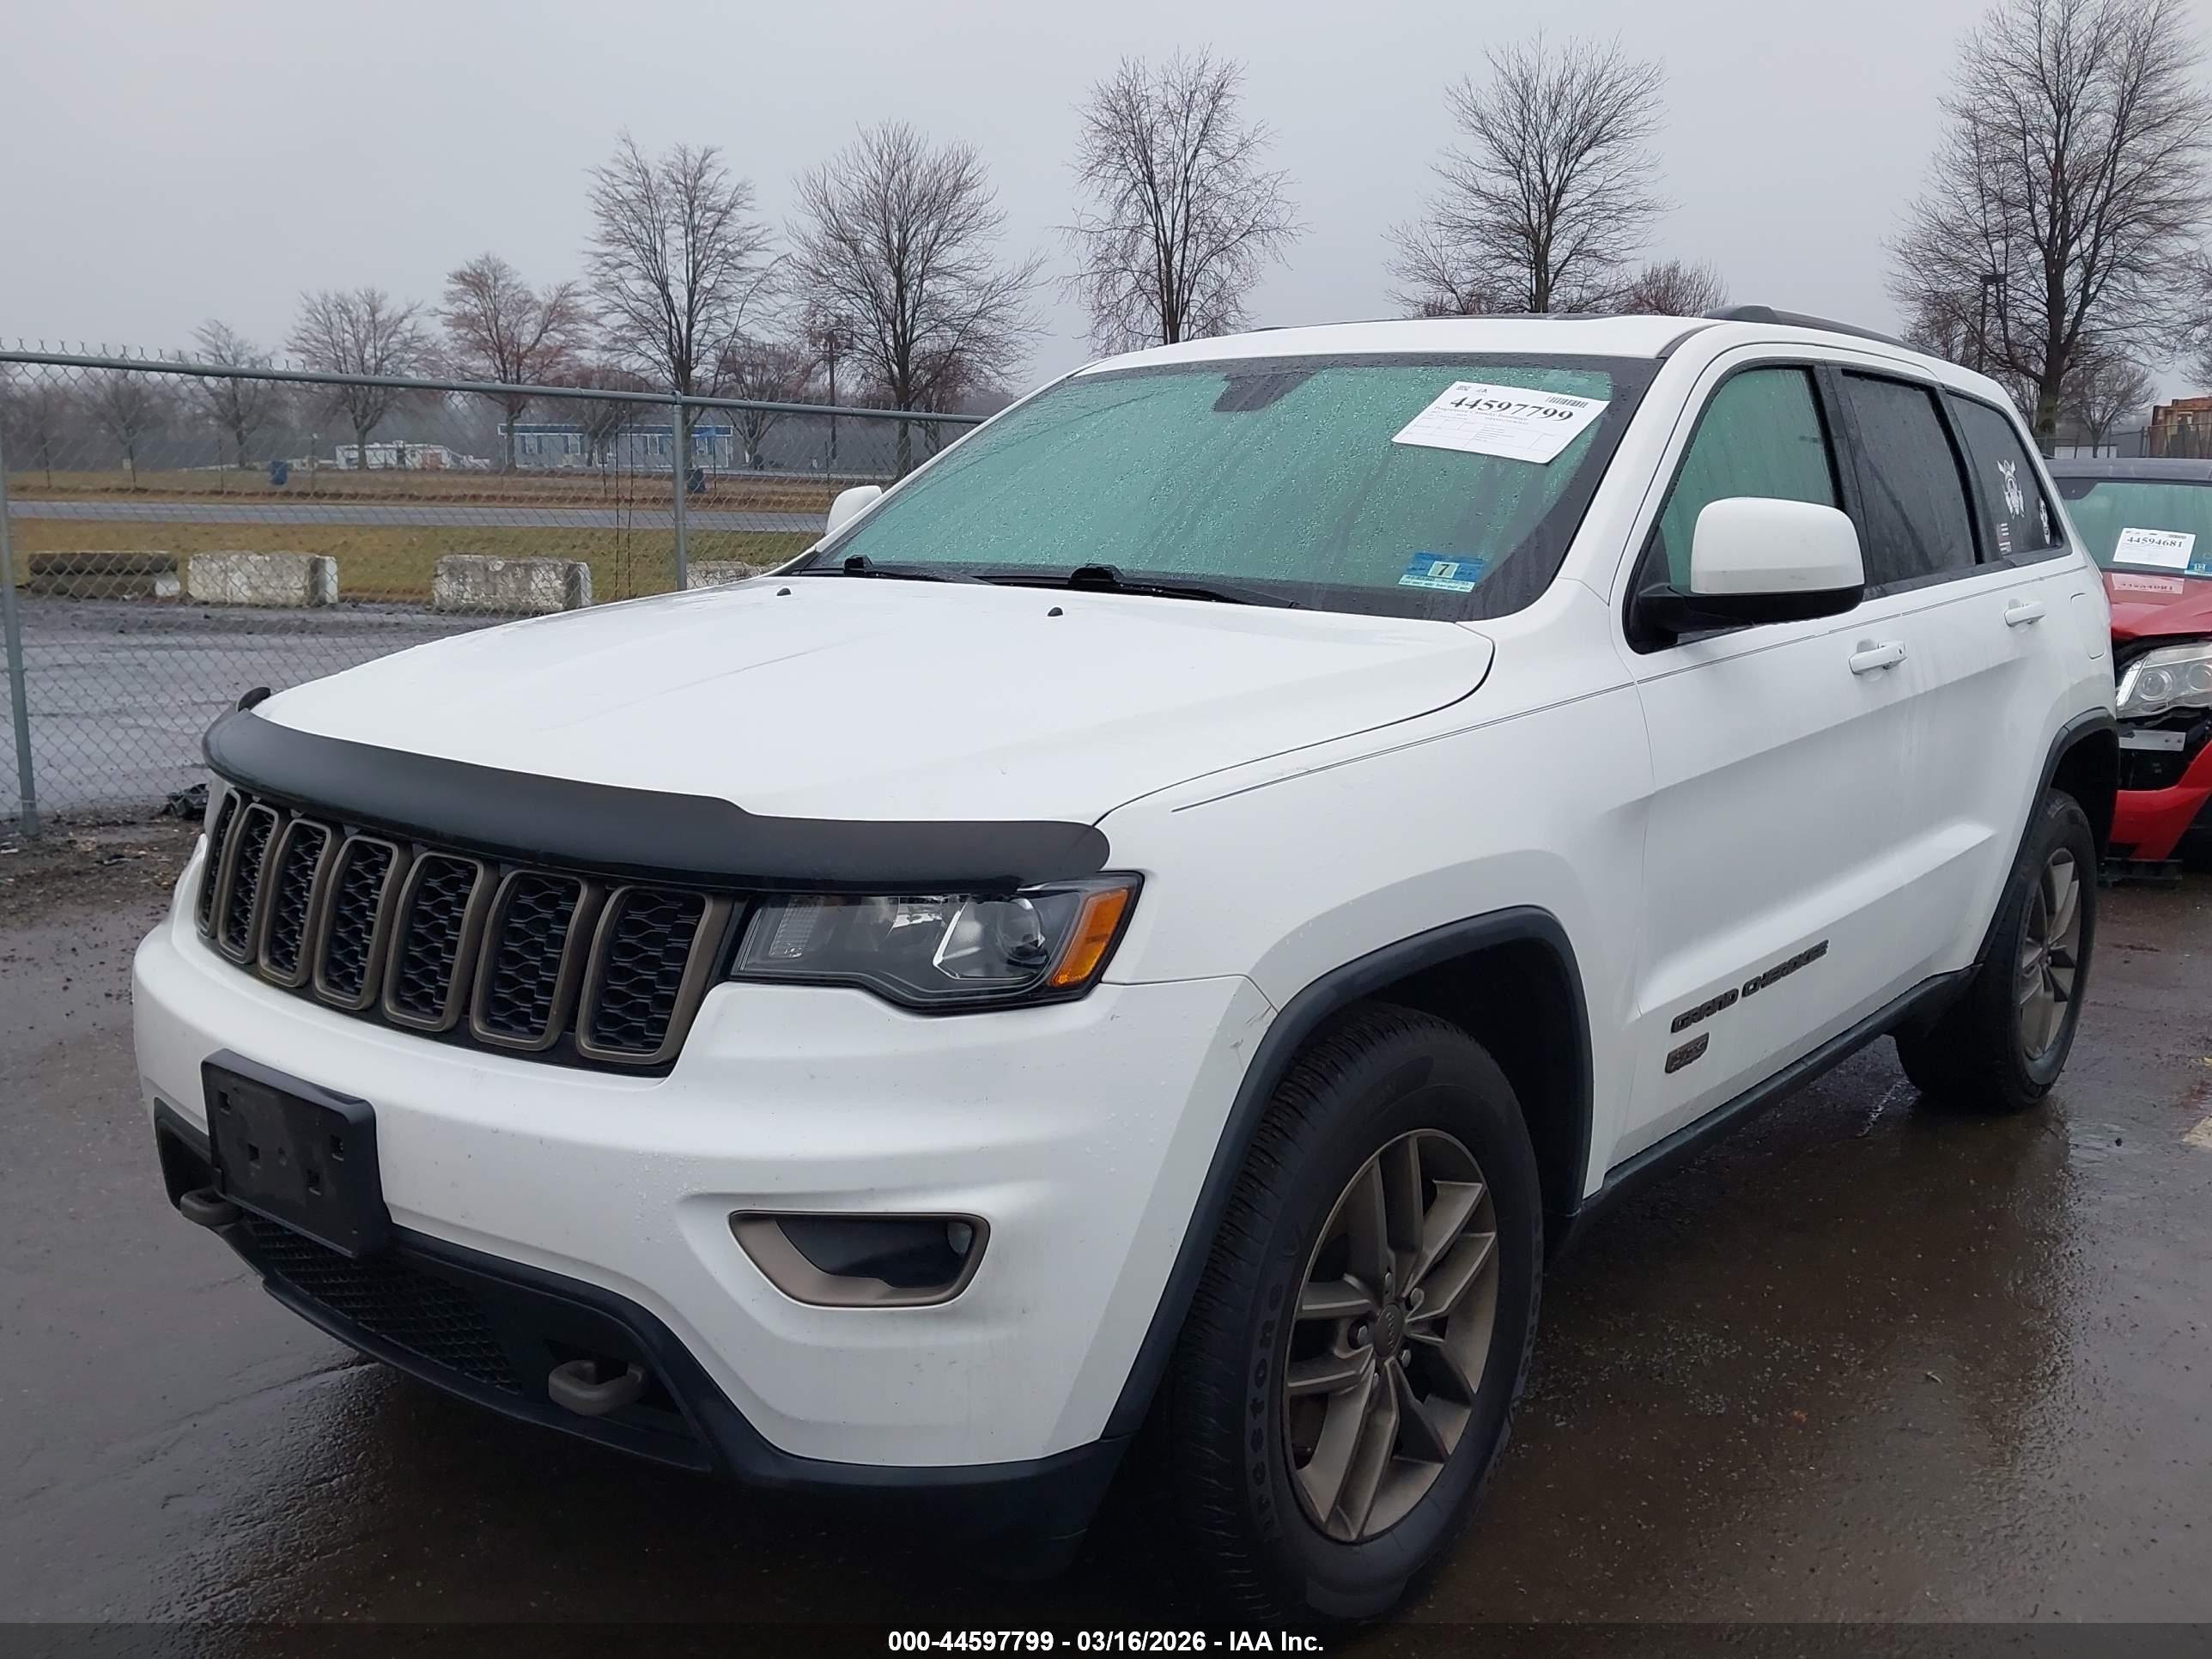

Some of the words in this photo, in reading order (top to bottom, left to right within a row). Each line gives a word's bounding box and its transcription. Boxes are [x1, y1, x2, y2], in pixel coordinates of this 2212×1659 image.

[1449, 395, 1574, 422] 44597799
[2126, 536, 2184, 549] 44594681
[1437, 563, 1449, 575] 7
[1670, 988, 1739, 1033] GRAND
[1741, 939, 1830, 998] CHEROKEE
